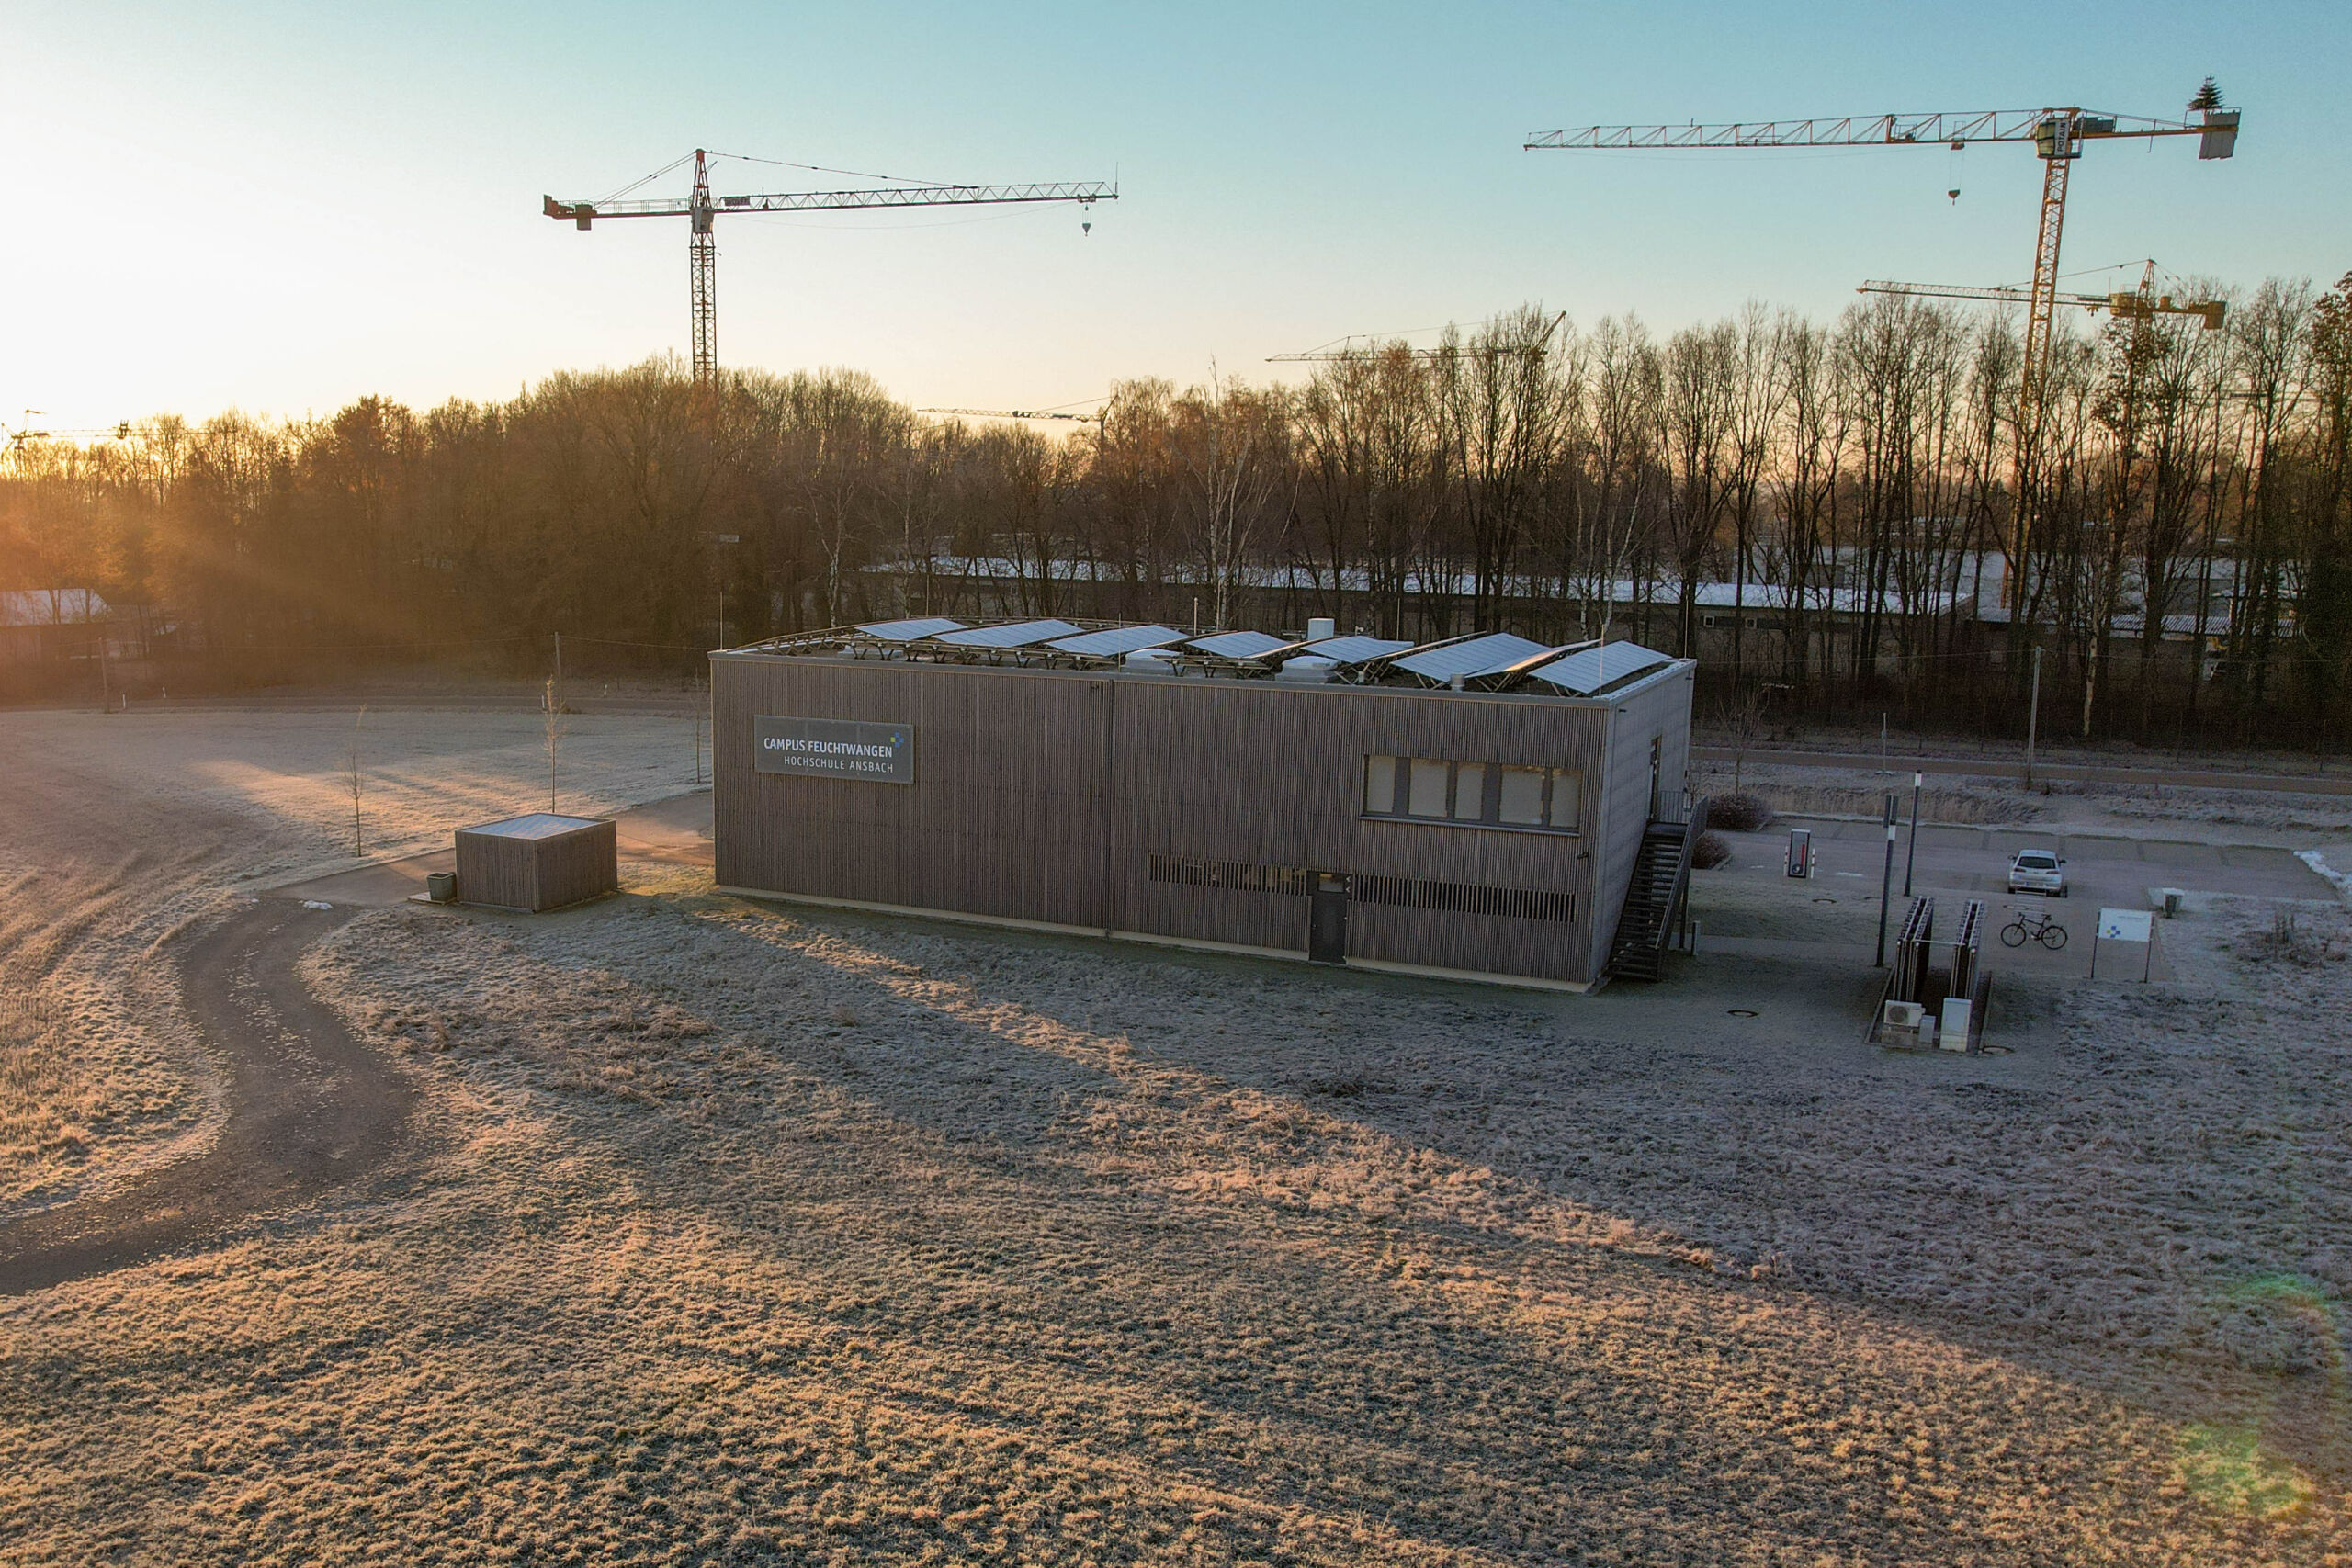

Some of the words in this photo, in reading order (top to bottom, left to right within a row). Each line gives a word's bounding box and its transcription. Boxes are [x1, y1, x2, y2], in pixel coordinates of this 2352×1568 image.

[2056, 122, 2066, 152] POTAIN
[763, 737, 806, 752] CAMPUS
[808, 740, 893, 758] FEUCHTWANGEN
[784, 756, 845, 770] HOCHSCHULE
[849, 761, 893, 773] ANSBACH
